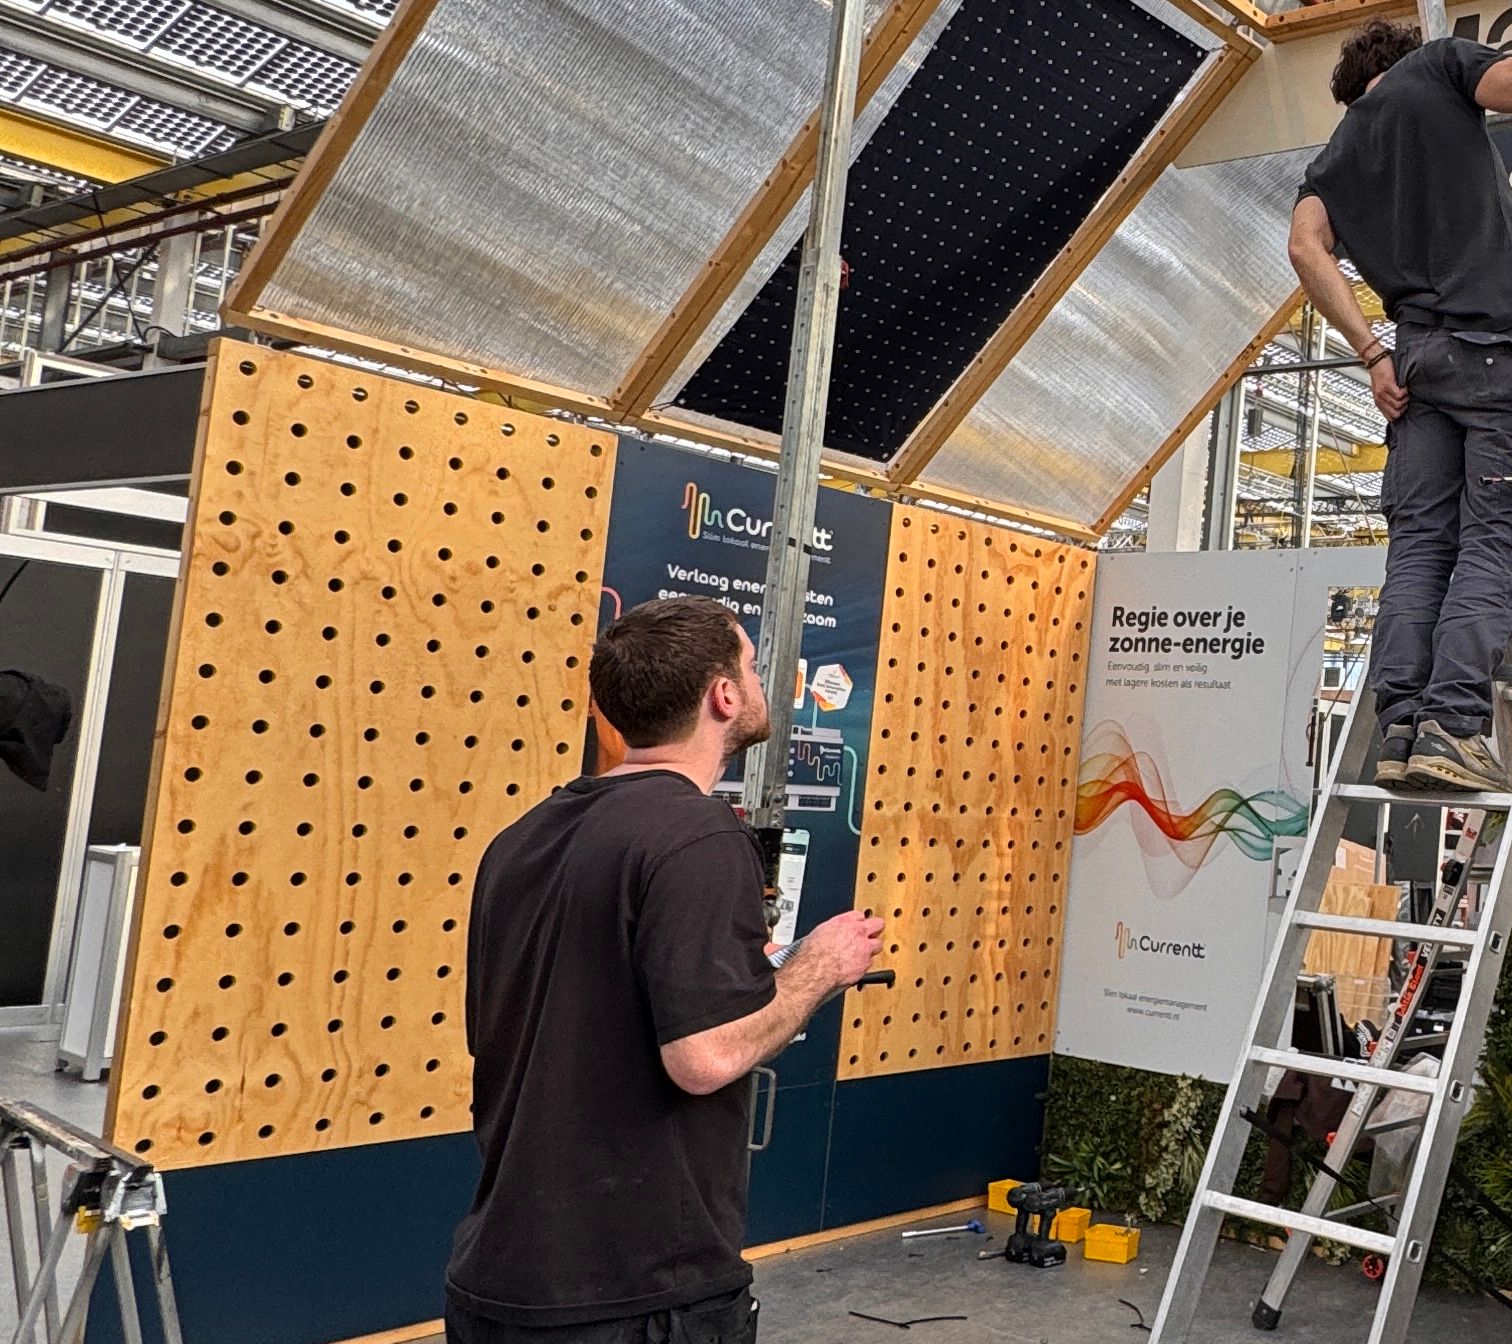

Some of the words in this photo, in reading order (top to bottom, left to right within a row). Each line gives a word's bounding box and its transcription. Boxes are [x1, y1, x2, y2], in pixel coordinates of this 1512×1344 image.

[727, 508, 833, 551] Curtt
[667, 563, 729, 592] Verlaag
[743, 601, 761, 616] en
[1112, 605, 1168, 633] Regie
[1173, 610, 1222, 628] over
[1223, 605, 1246, 633] je
[1108, 631, 1265, 660] zonne-energie
[1140, 935, 1206, 959] Currentt
